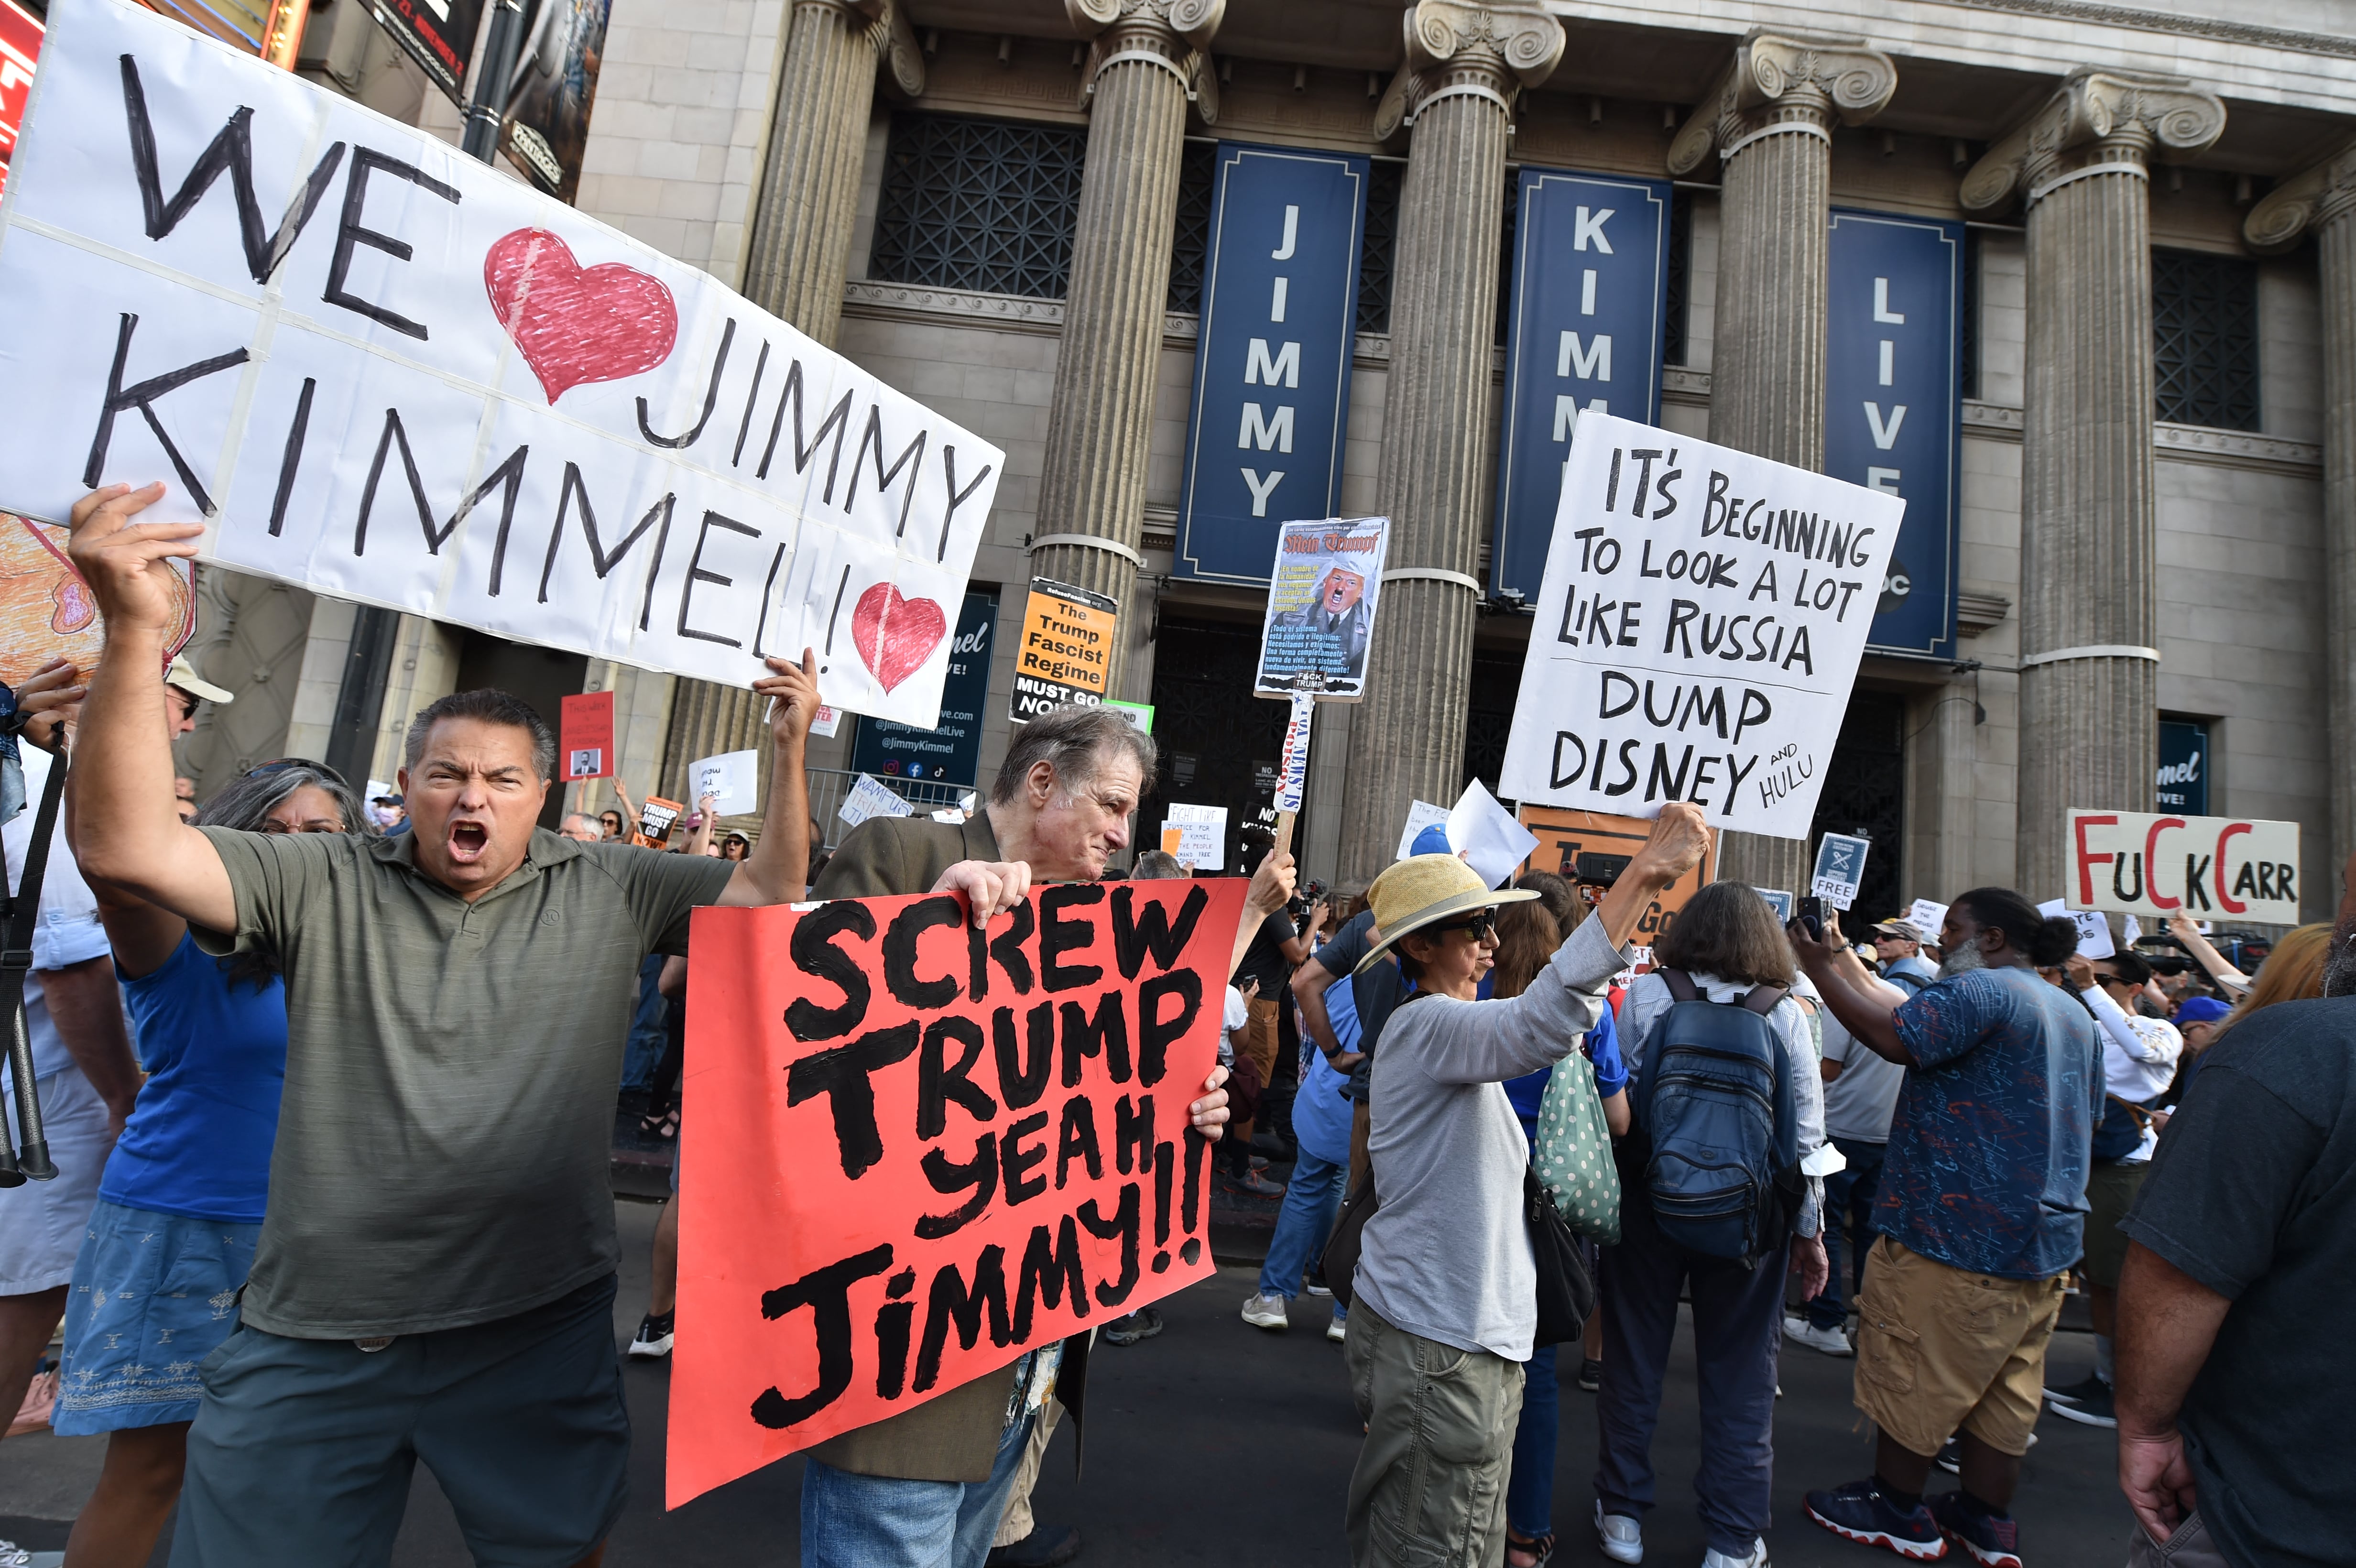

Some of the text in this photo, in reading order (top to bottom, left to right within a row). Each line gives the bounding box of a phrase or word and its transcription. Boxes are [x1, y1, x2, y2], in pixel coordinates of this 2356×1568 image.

[456, 61, 464, 76] 2
[513, 124, 560, 180] PANTAGES
[118, 54, 462, 341] WE
[635, 317, 992, 563] JIMMY
[1551, 205, 1615, 485] KIMM
[1237, 204, 1301, 517] JIMMY
[1605, 447, 1876, 569] IT'S BEGINNING
[1285, 531, 1381, 555] Mein Trumpf
[1574, 526, 1863, 623] TO LOOK A LOT
[1058, 602, 1087, 621] The
[1039, 614, 1100, 645] Trump
[1283, 633, 1305, 641] podrido
[1557, 584, 1814, 677] LIKE RUSSIA
[1028, 632, 1103, 665] Fascist
[1297, 649, 1343, 657] completamente
[1024, 652, 1101, 685] Regime
[1319, 665, 1350, 674] diferente!
[1016, 677, 1100, 708] MUST GO
[1296, 679, 1323, 688] TRUMP
[814, 711, 832, 722] TER
[1599, 670, 1772, 746] DUMP
[882, 737, 954, 754] @JimmyKimmel
[1276, 721, 1298, 795] POISON
[1261, 766, 1273, 774] NO
[1549, 730, 1813, 817] DISNEY AND HULU
[644, 803, 678, 820] TRUMP
[1258, 807, 1276, 822] NO
[1283, 793, 1301, 809] IS
[1417, 804, 1431, 814] The
[642, 813, 670, 830] MUST
[644, 825, 659, 838] GO
[636, 836, 663, 849] NOW!
[2214, 822, 2298, 914] CARR
[1817, 880, 1852, 897] FREE
[782, 883, 1209, 1042] SCREW
[784, 967, 1204, 1180] TRUMP
[914, 1094, 1156, 1240] YEAH
